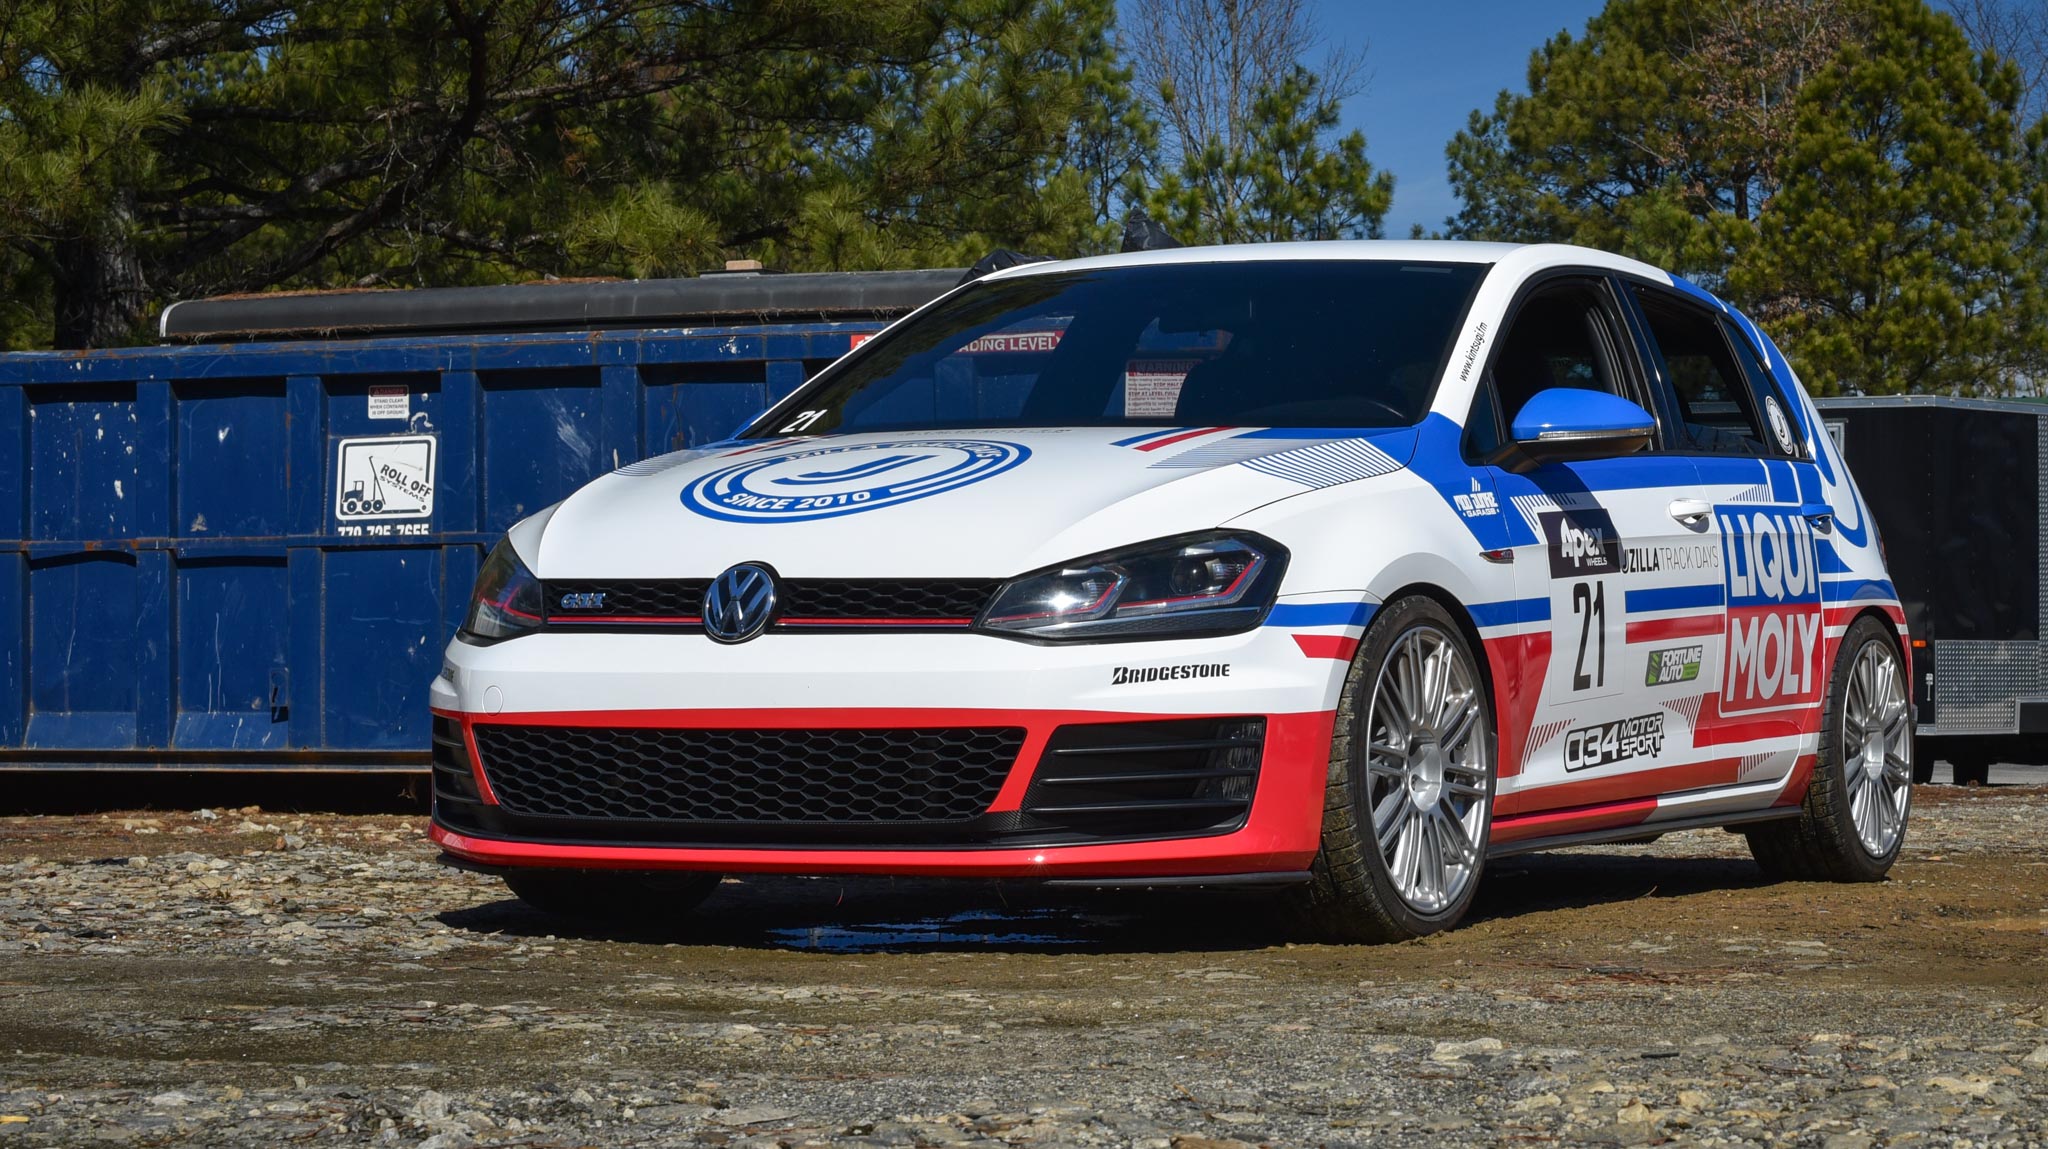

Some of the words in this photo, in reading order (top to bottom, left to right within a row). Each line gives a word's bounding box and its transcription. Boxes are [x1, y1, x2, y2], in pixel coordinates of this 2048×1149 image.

[958, 338, 1006, 353] ADING
[1009, 336, 1057, 351] LEVEL
[1459, 321, 1488, 382] www.kintsugi.fm
[778, 409, 828, 433] 21
[380, 464, 408, 486] ROLL
[410, 480, 432, 497] OFF
[380, 475, 425, 503] SYSTEMS
[723, 493, 795, 510] SINCE
[794, 491, 871, 509] 2010
[1586, 557, 1608, 567] WHEELS
[1695, 545, 1719, 569] DAYS
[1720, 512, 1816, 602] LIQUI
[560, 592, 607, 609] GTI
[1573, 581, 1605, 691] 21
[1661, 647, 1702, 667] FORTUNE
[1726, 612, 1821, 702] MOLY
[1111, 663, 1230, 685] BRIDGESTONE
[1658, 664, 1683, 683] AUTO
[1566, 723, 1620, 771] 034
[1620, 714, 1663, 739] MOTOR
[1621, 732, 1662, 757] SPORT
